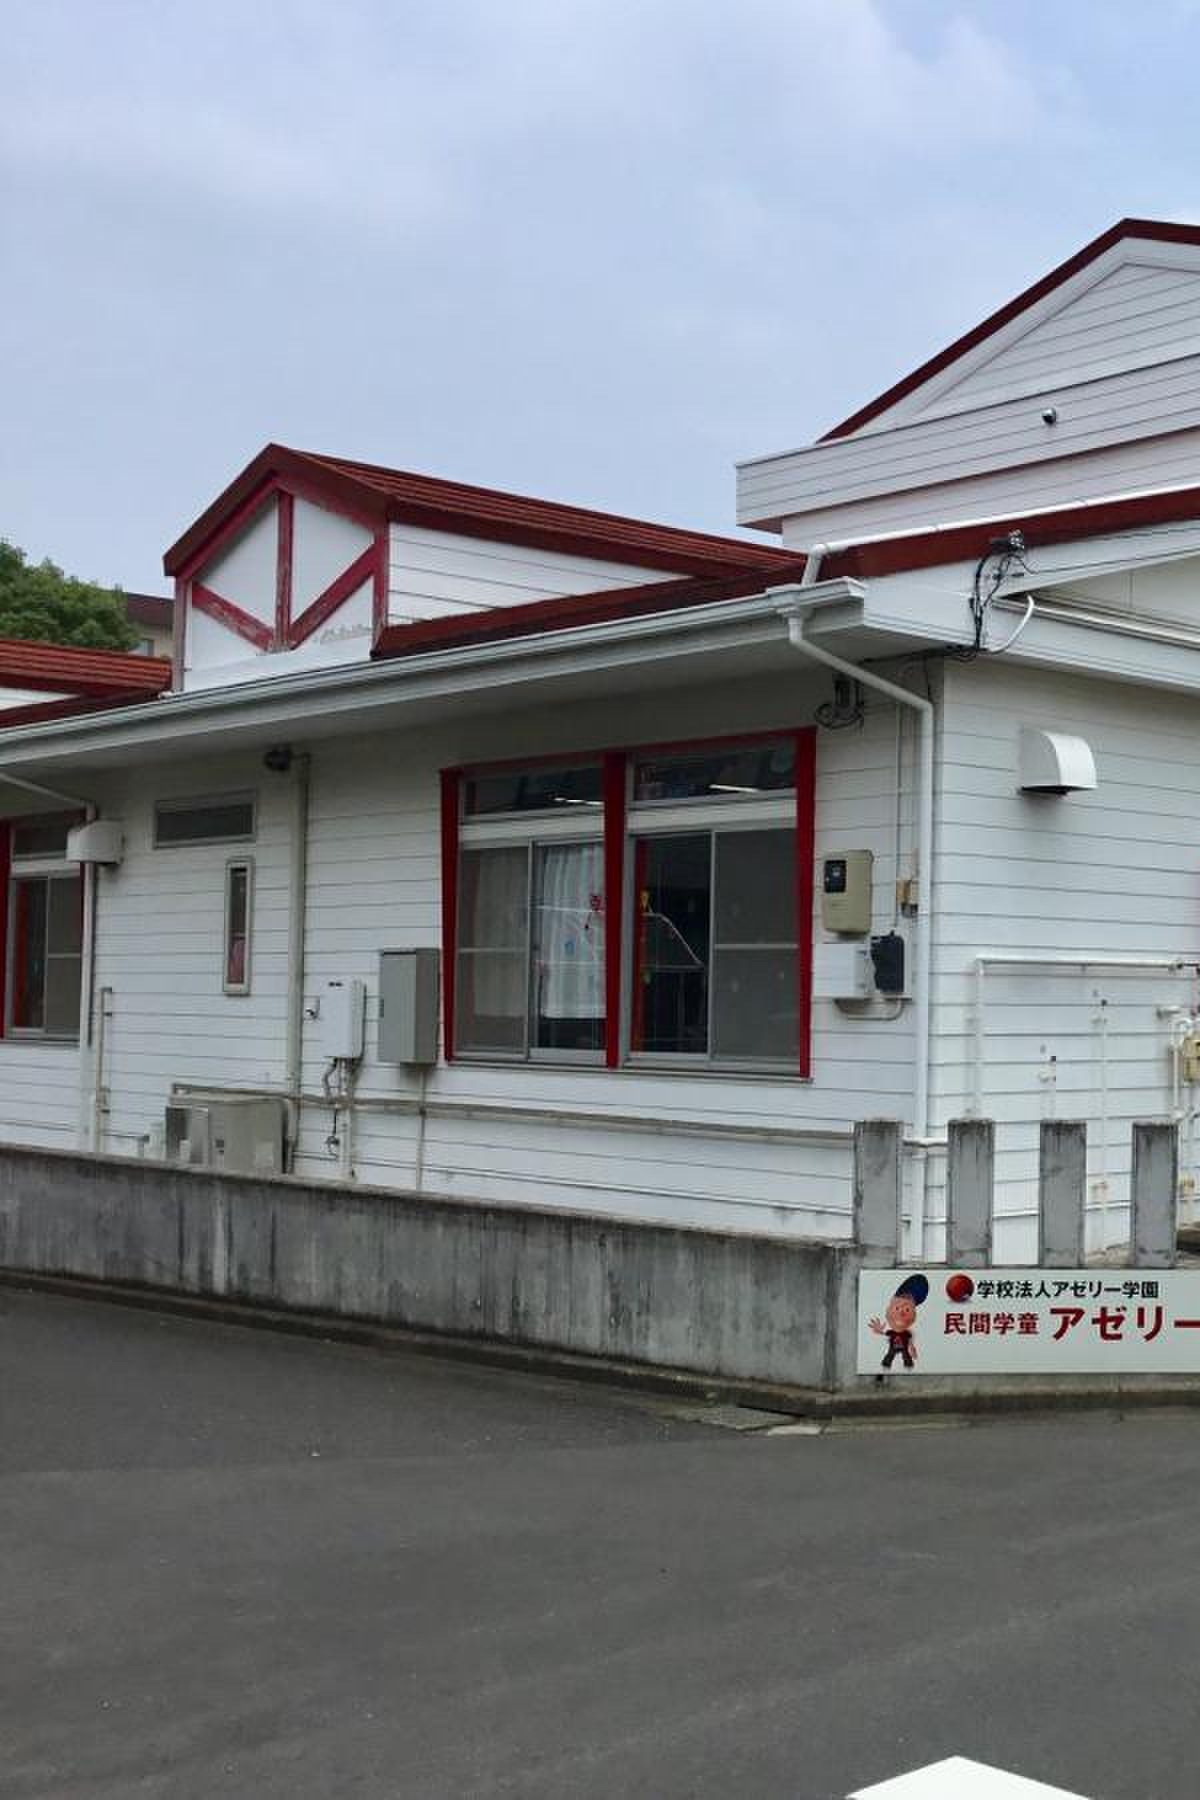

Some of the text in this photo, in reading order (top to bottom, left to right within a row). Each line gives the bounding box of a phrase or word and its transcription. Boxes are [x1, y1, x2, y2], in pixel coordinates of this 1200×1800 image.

[977, 1280, 1159, 1298] 学校法人アゼリー学園
[944, 1312, 1039, 1335] 民間学童
